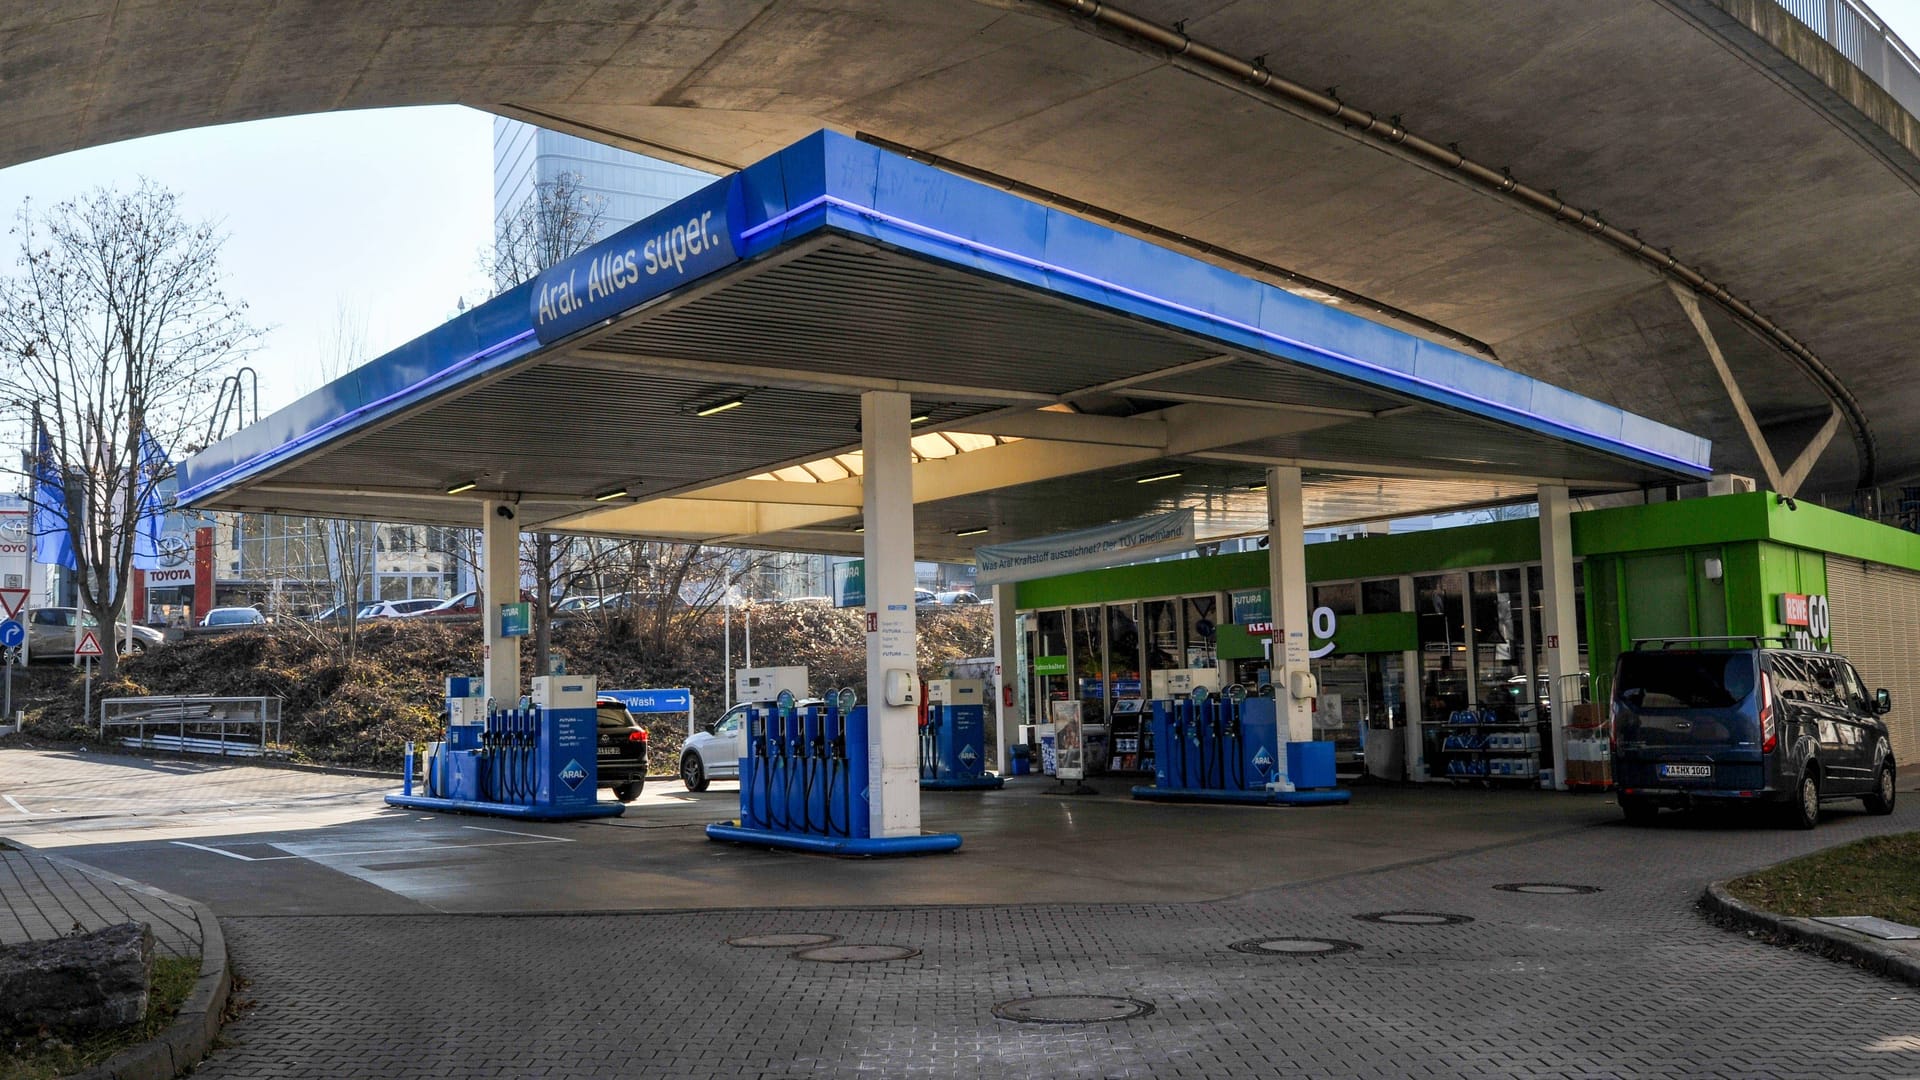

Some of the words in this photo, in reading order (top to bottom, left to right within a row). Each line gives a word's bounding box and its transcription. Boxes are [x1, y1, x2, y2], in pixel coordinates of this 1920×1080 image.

[538, 269, 582, 325] Aral.
[588, 250, 639, 303] Alles
[643, 210, 719, 274] super.
[982, 561, 997, 571] Was
[999, 557, 1013, 568] Aral
[1014, 551, 1049, 566] Kraftstoff
[1050, 542, 1101, 560] auszeichnet?
[1102, 540, 1117, 551] Der
[1119, 534, 1138, 548] TÜV
[1139, 526, 1184, 545] Rheinland.
[150, 569, 191, 582] TOYOTA
[1233, 594, 1262, 606] FUTURA
[1248, 622, 1273, 632] REW
[1312, 606, 1336, 639] O
[1785, 598, 1808, 621] REWE
[1808, 595, 1830, 638] GO
[1261, 639, 1272, 660] T
[1253, 756, 1272, 765] ARAL
[562, 769, 585, 779] ARAL
